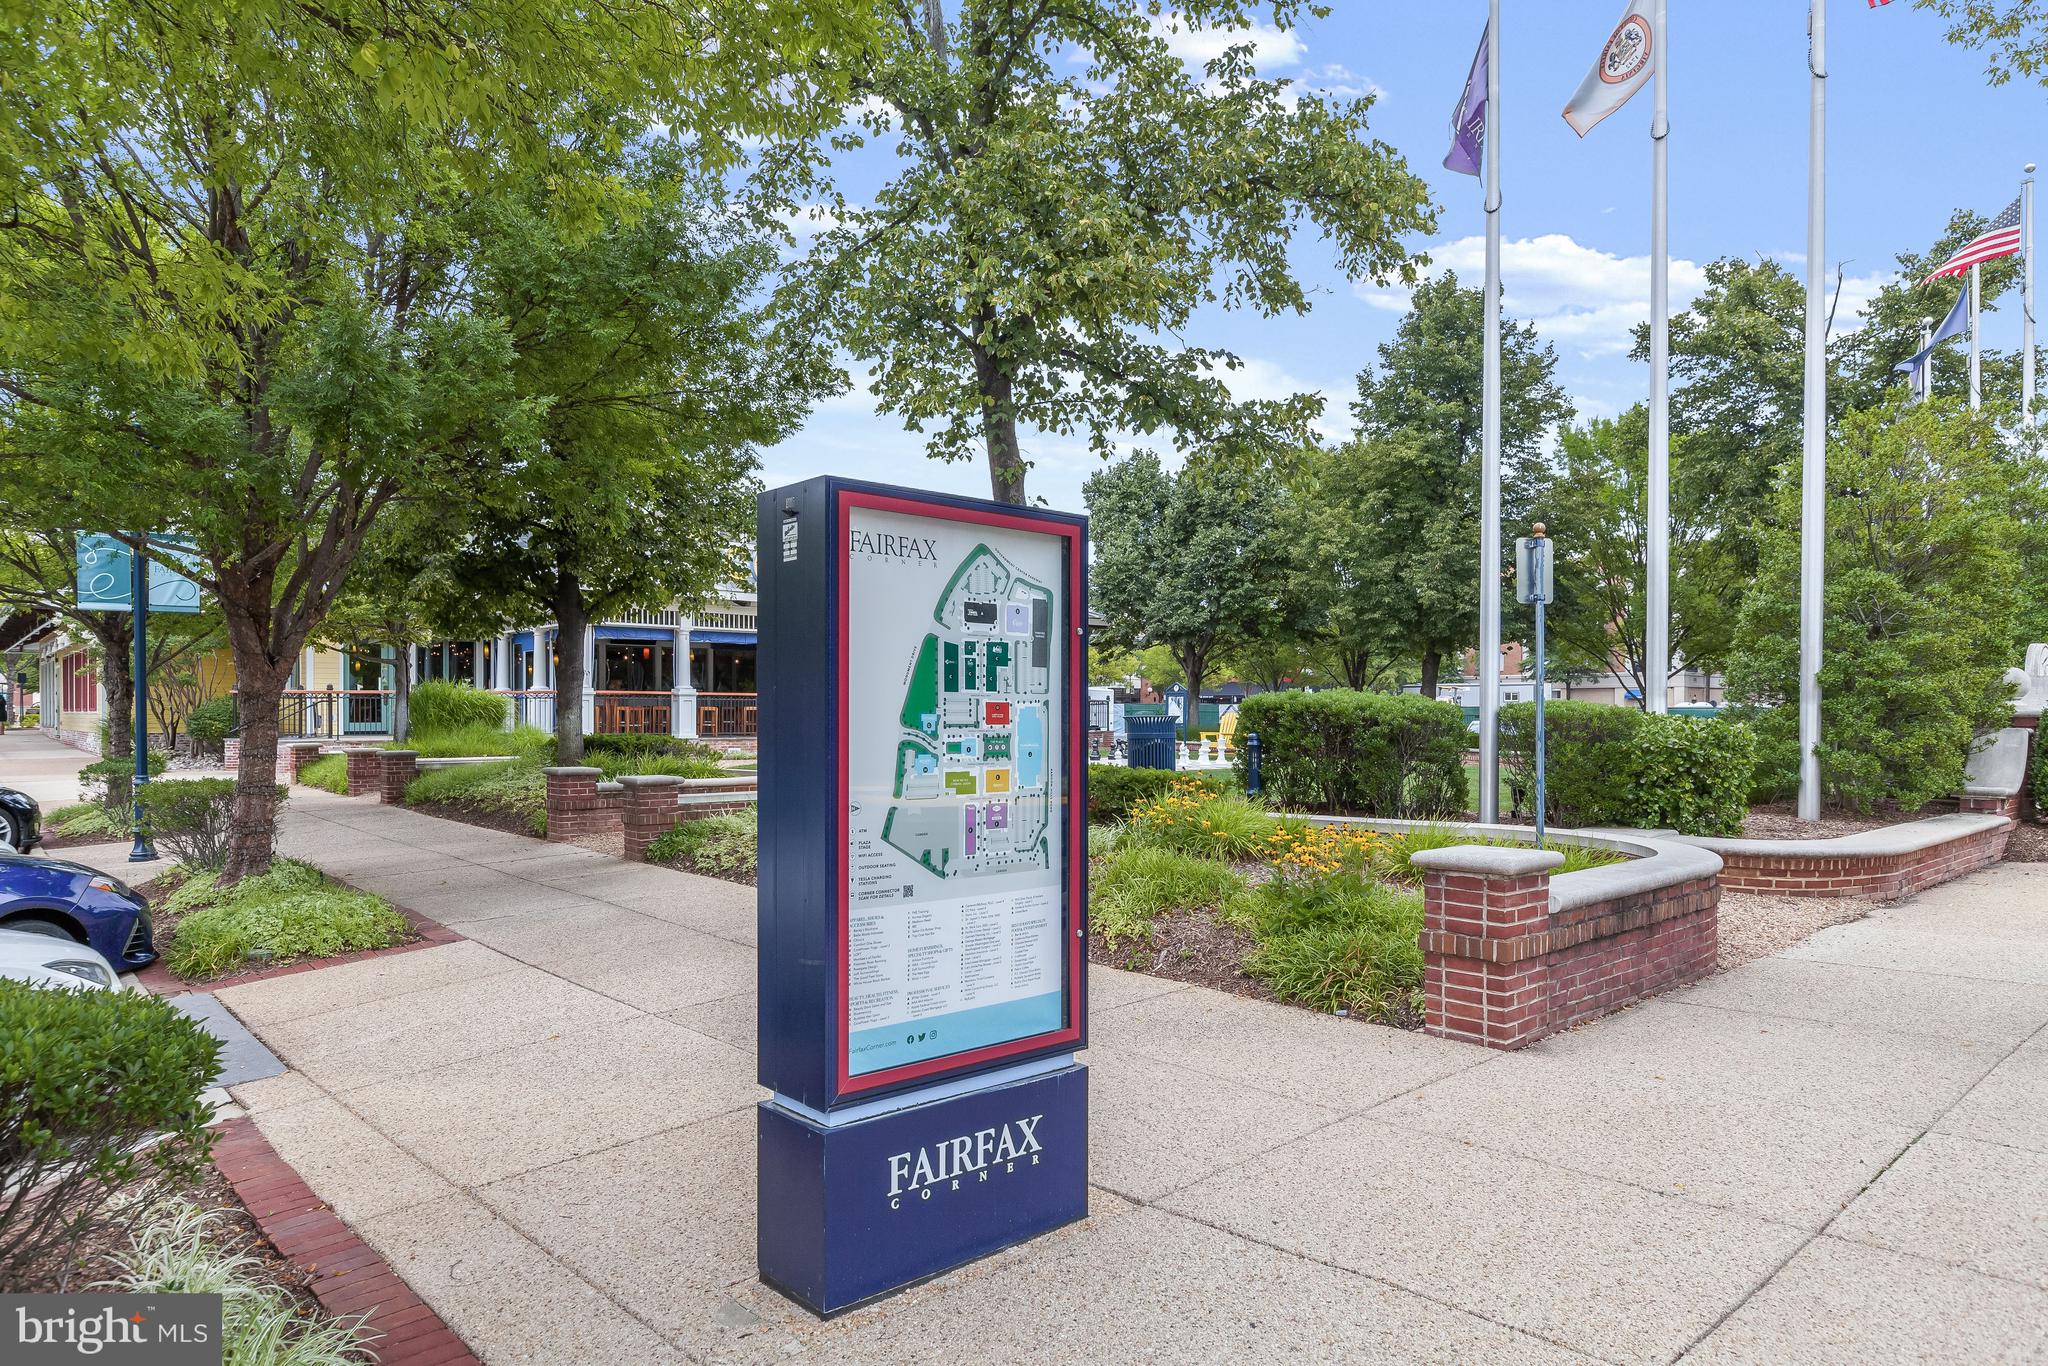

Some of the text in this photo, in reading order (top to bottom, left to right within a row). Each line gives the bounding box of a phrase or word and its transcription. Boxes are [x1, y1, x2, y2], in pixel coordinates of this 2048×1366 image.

[850, 554, 938, 568] CORNER
[851, 530, 937, 560] FAIRFAX
[887, 1114, 1043, 1197] FAIRFAX
[891, 1155, 1039, 1209] CORNER
